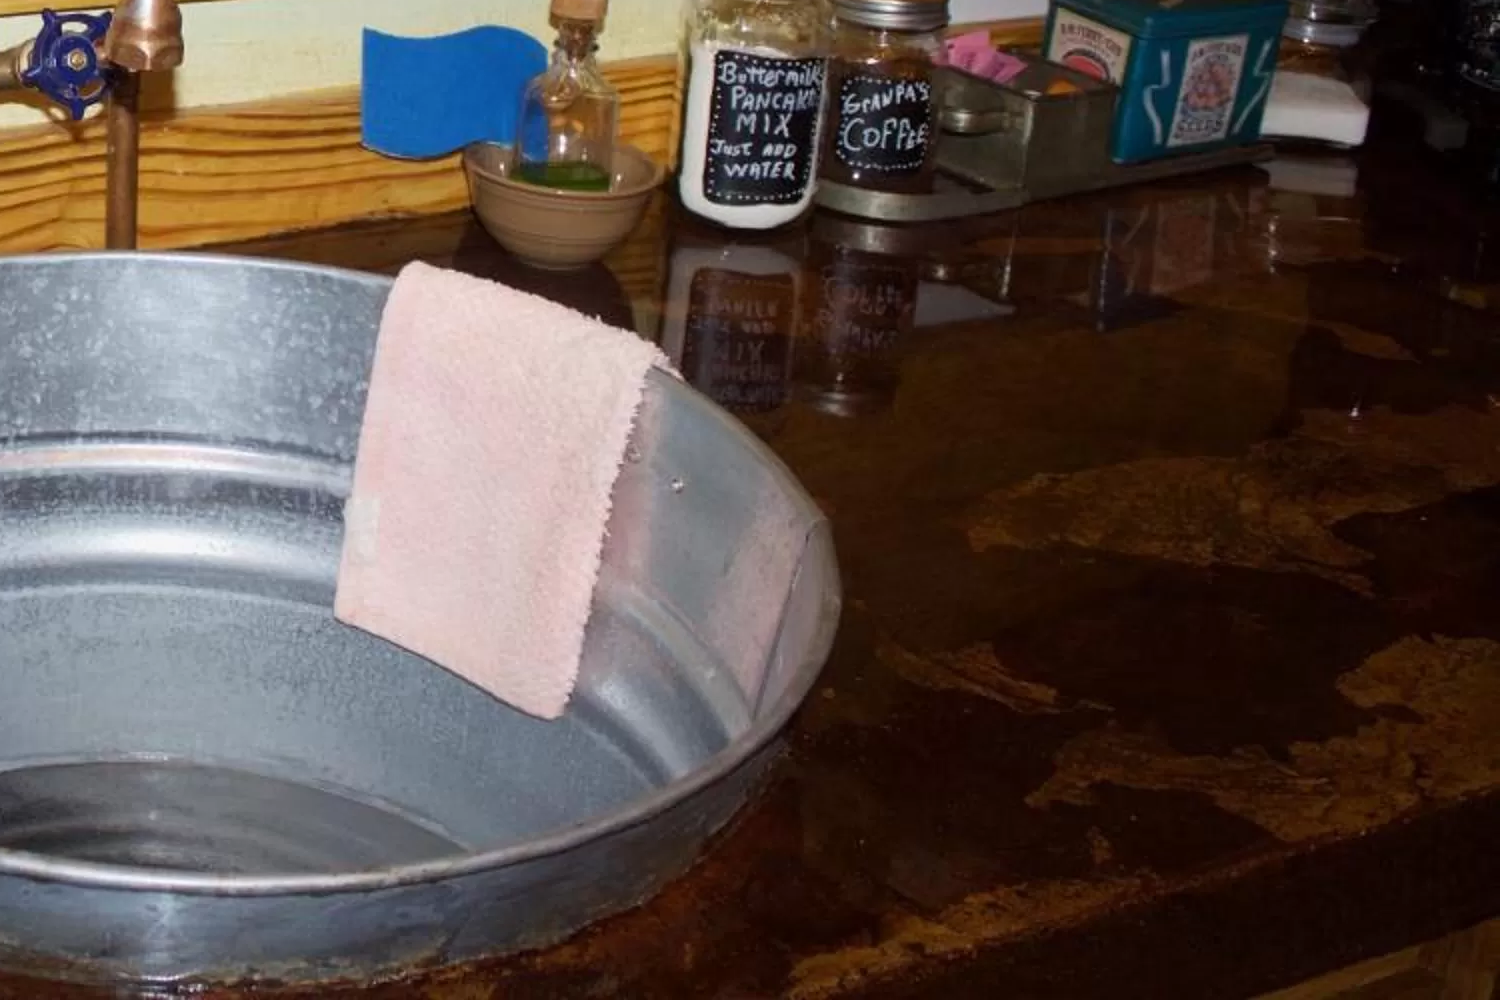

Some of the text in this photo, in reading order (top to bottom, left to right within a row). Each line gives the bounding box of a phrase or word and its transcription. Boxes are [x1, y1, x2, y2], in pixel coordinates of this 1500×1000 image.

[718, 61, 823, 87] Buttermilk
[736, 113, 792, 138] MIX
[763, 144, 797, 158] ADD
[724, 162, 795, 180] WATER
